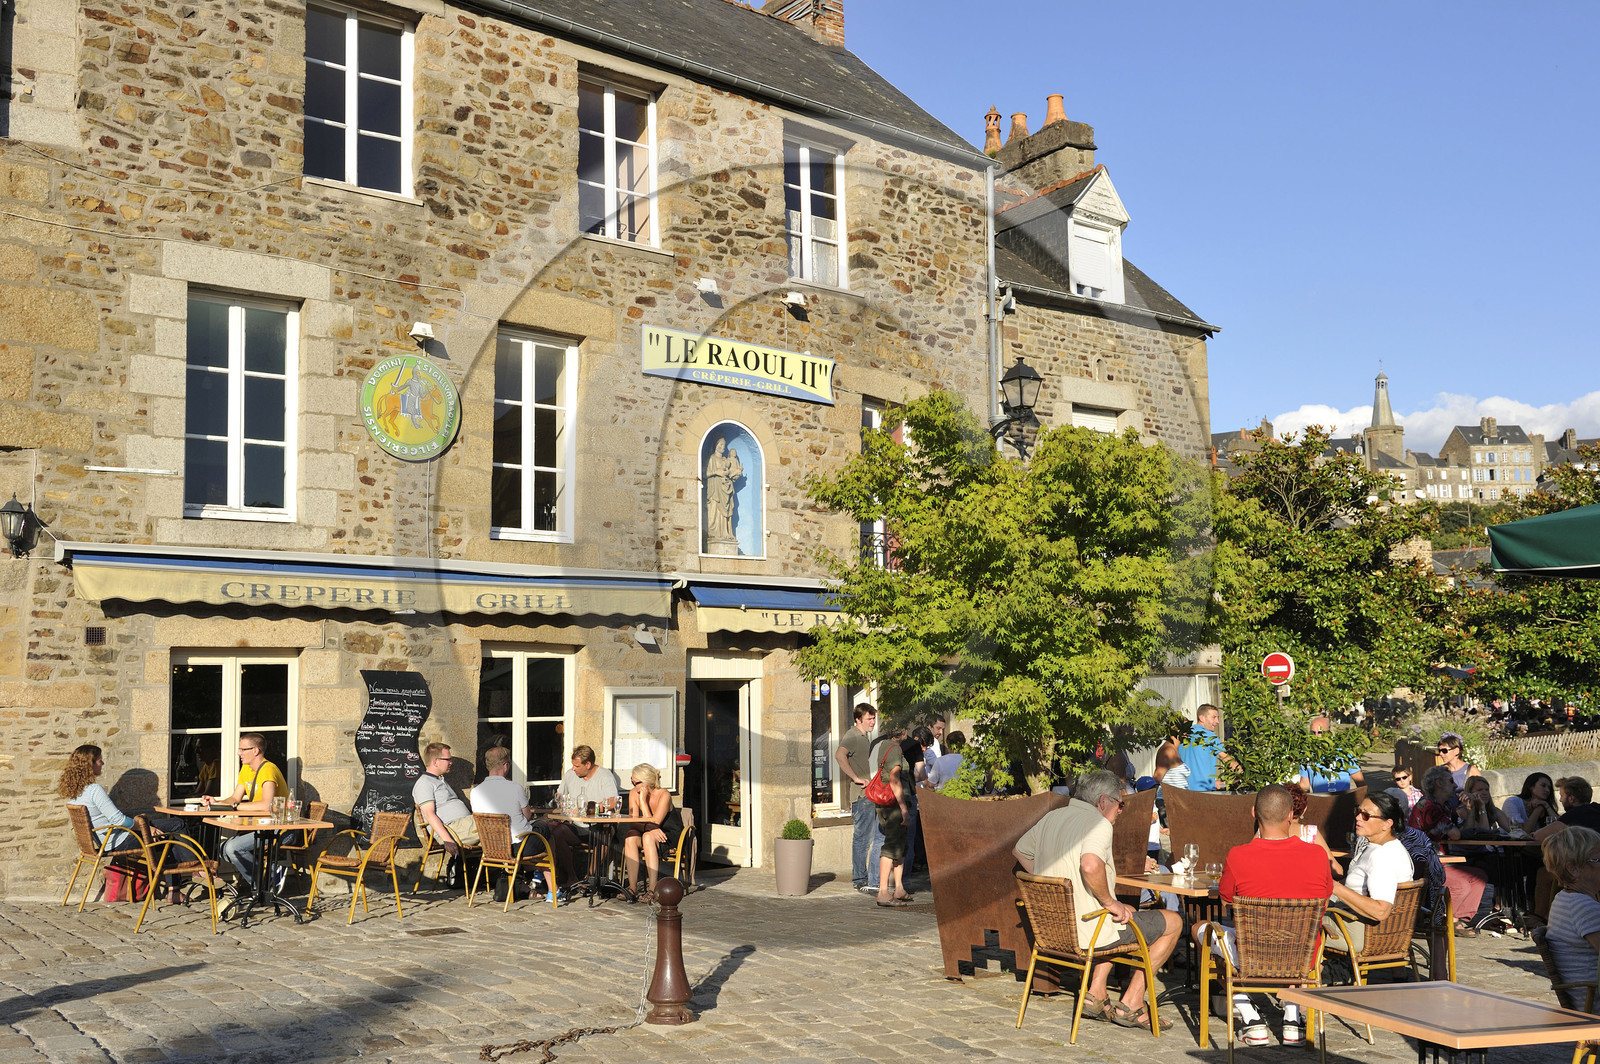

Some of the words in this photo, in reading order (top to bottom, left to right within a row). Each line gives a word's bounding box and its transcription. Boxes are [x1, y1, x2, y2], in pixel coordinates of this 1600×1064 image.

[707, 342, 794, 381] RAOUL
[692, 369, 793, 395] CRÊPERIE-GRILL
[220, 581, 417, 606] CREPERIE
[475, 592, 574, 609] GRILL
